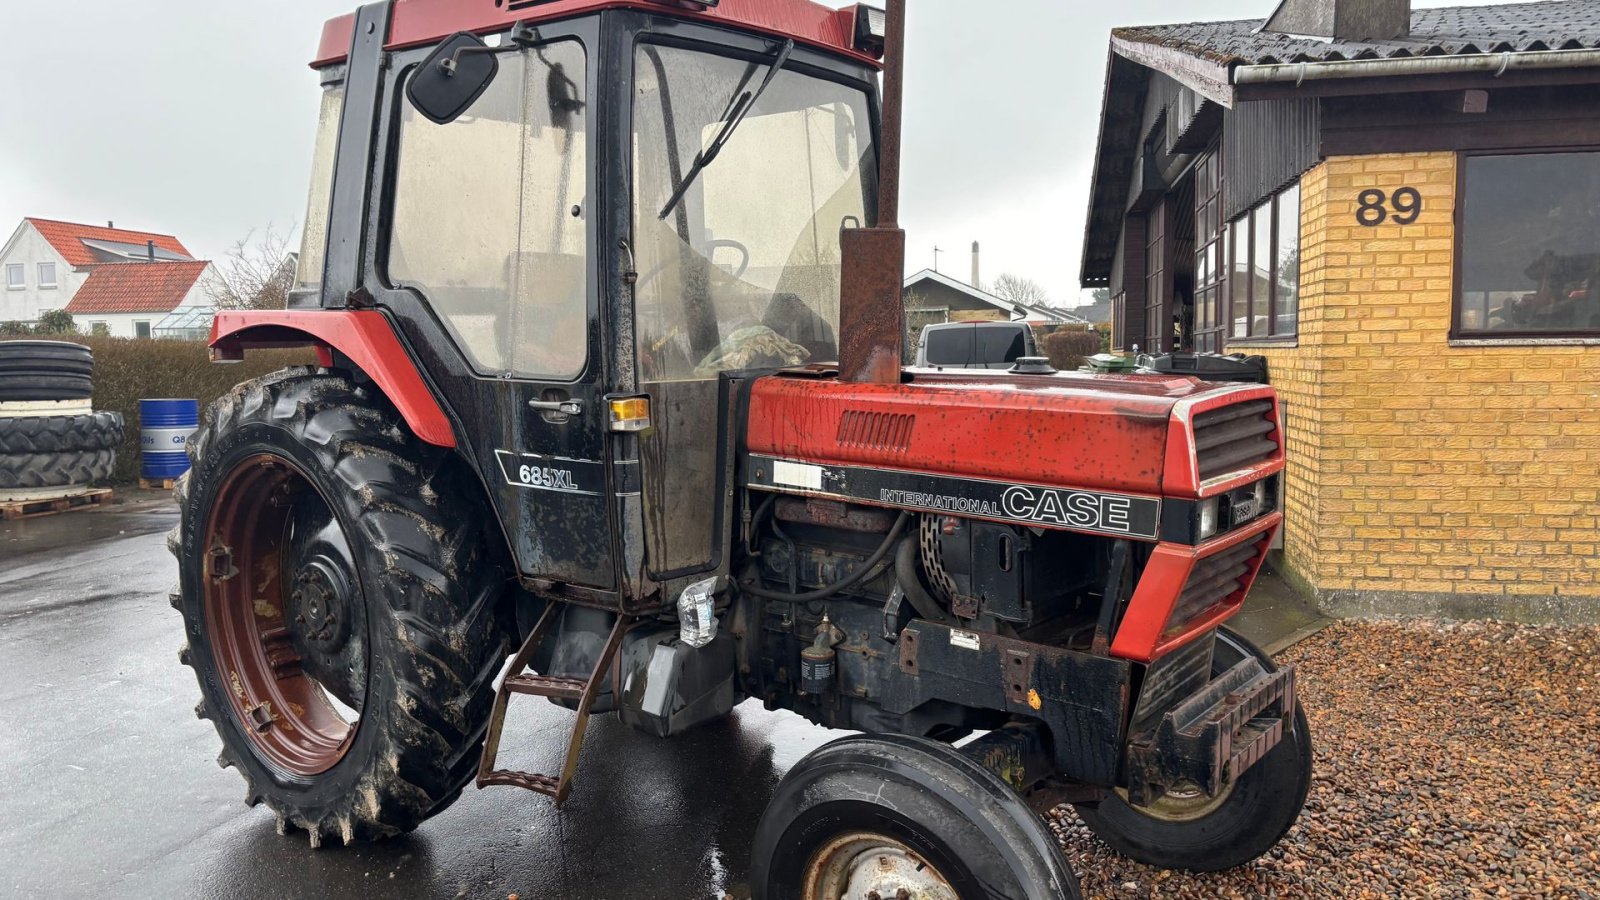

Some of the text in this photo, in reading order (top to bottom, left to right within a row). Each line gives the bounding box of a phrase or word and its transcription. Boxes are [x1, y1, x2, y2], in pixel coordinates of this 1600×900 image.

[1355, 186, 1422, 227] 89
[172, 435, 186, 444] Q8
[519, 464, 578, 490] 685XL
[879, 485, 1130, 532] INTERNATIONAL CASE
